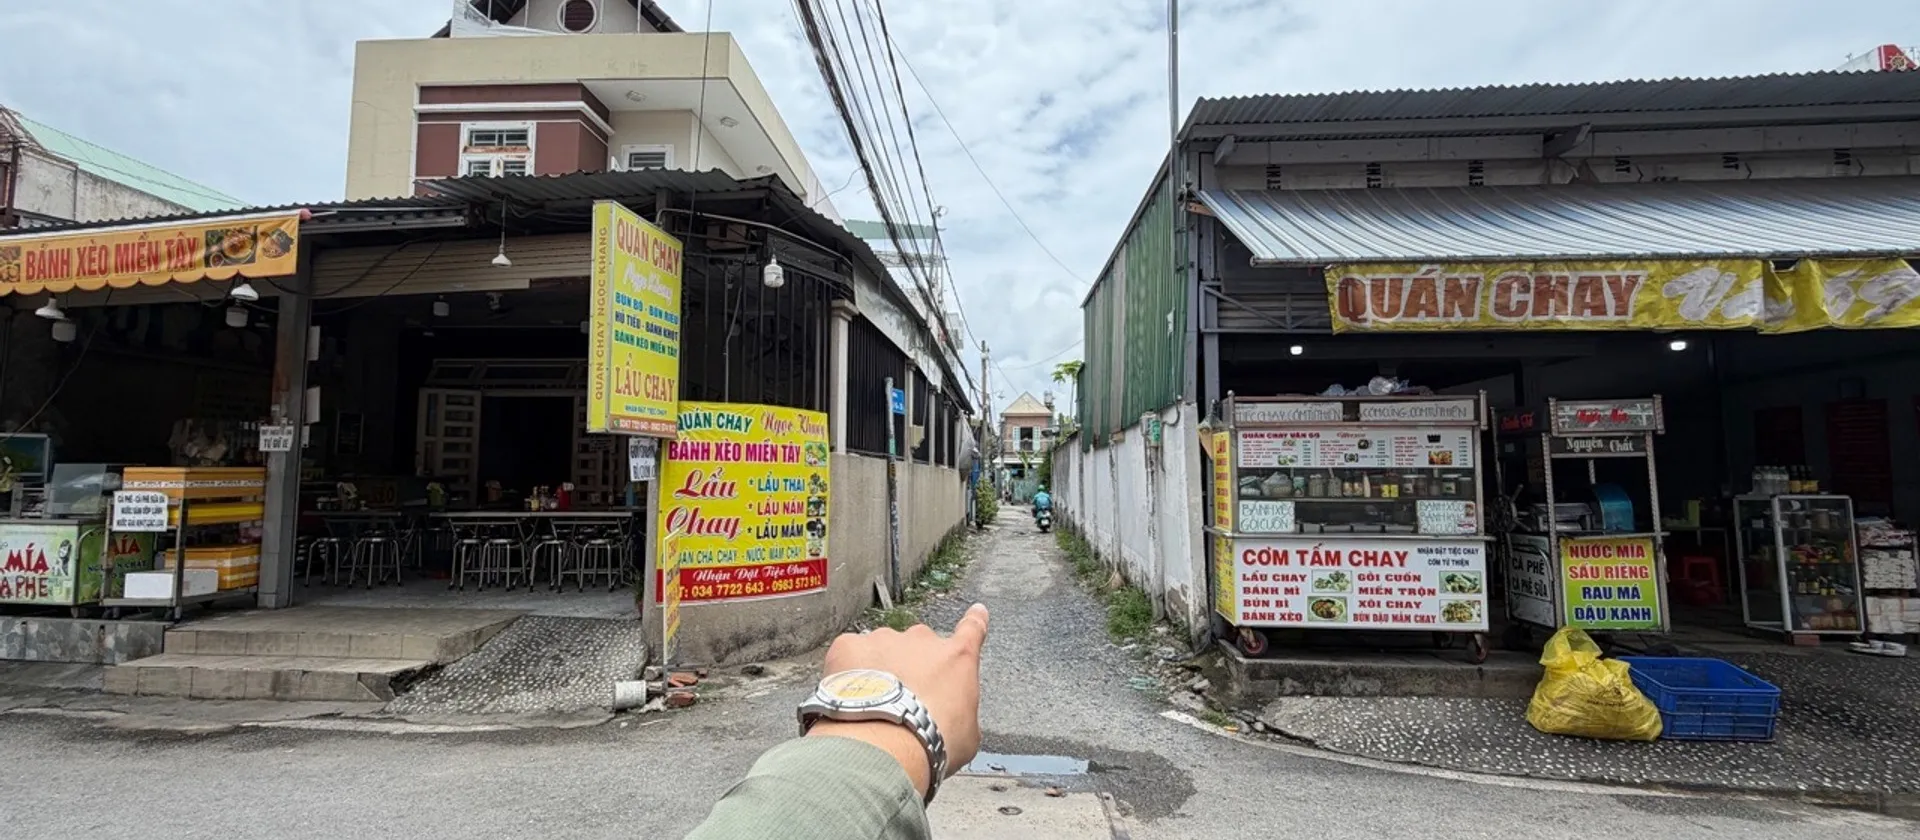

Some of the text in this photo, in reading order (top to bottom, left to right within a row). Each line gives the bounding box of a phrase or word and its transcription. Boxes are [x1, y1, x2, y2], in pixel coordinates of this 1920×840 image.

[26, 231, 199, 280] BÁNH XÈO MIỀN TÂY
[598, 227, 607, 274] KHANG
[652, 238, 681, 277] CHAY
[597, 279, 607, 316] NGỌC
[1336, 268, 1479, 323] QUÁN
[1495, 274, 1642, 318] CHAY
[596, 321, 605, 358] CHAY
[615, 329, 635, 346] BÁNH
[615, 352, 676, 403] LẨU CHAY
[678, 406, 712, 430] QUÁN
[715, 412, 753, 433] CHAY
[668, 436, 711, 461] BÁNH
[714, 437, 741, 462] XÈO
[745, 438, 777, 462] MIỀN
[782, 441, 801, 463] TÂY
[1566, 435, 1634, 453] Nguyên Chất
[674, 467, 738, 499] Lẩu
[757, 471, 780, 492] LẨU
[757, 495, 779, 515] LẨU
[666, 507, 741, 540] Chay
[756, 518, 779, 539] LẨU
[4, 542, 49, 575] MÍA
[717, 549, 738, 563] CHAY
[787, 546, 802, 559] CHAY
[1242, 542, 1409, 567] CƠM TẤM CHAY
[1417, 547, 1433, 556] NHẬN
[1448, 547, 1461, 556] TIỆC
[1568, 543, 1612, 558] NƯỚC
[692, 570, 730, 583] Nhận
[787, 563, 810, 576] Chay
[1385, 570, 1421, 582] CUỐN
[1527, 559, 1545, 576] PHÊ
[691, 586, 712, 598] 034
[716, 583, 742, 597] 7722
[745, 582, 764, 594] 643
[772, 579, 793, 591] 0983
[795, 577, 808, 588] 573
[1272, 574, 1307, 582] CHAY
[1243, 584, 1300, 595] BÁNH MÌ
[1398, 587, 1437, 598] TRỘN
[1582, 583, 1641, 600] RAU MÁ
[1243, 597, 1289, 608] BÚN BÌ
[1358, 599, 1422, 609] XÔI CHAY
[1242, 609, 1303, 622] BÁNH XÈO
[1414, 614, 1437, 624] CHAY
[1574, 606, 1652, 624] ĐẬU XANH
